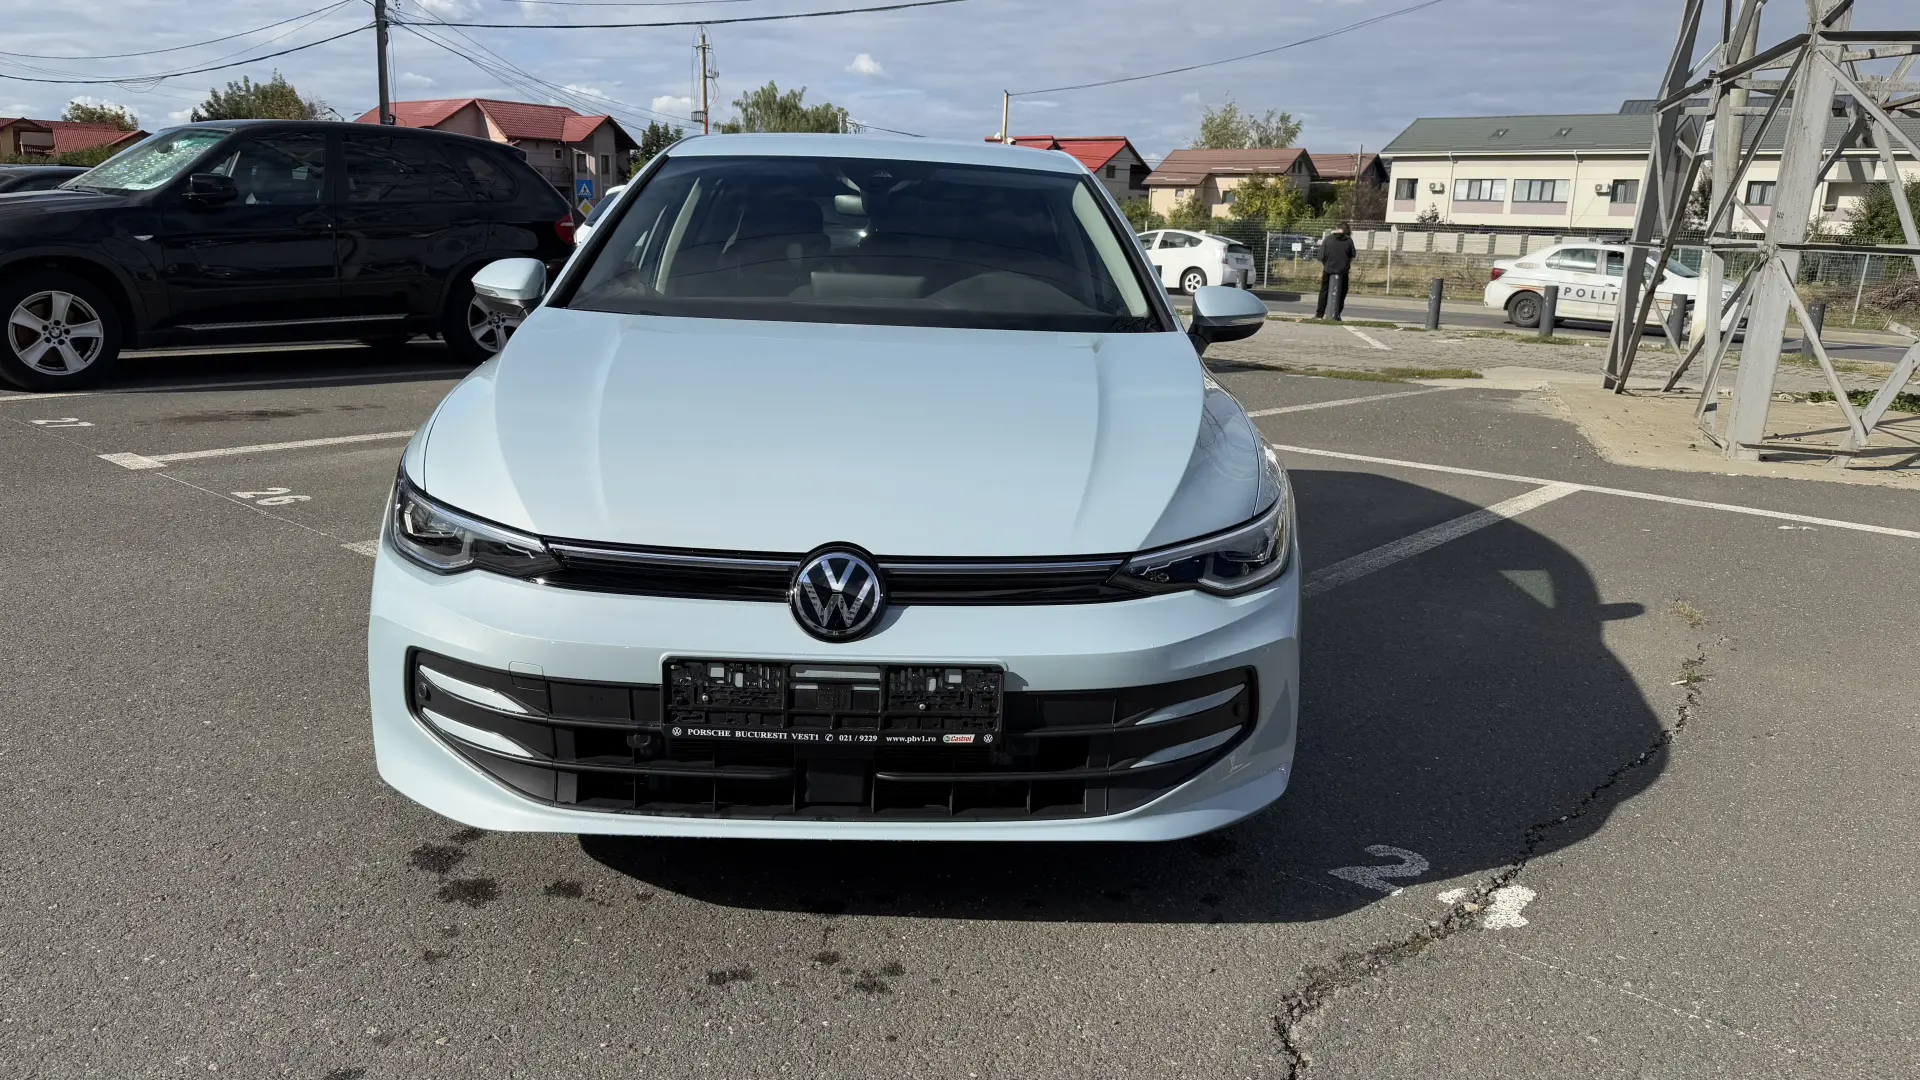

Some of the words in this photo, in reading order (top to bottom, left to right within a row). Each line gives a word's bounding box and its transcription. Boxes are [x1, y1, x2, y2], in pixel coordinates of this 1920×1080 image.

[1563, 286, 1619, 302] POLIT
[230, 487, 311, 506] 26
[687, 728, 731, 737] PORSCHE
[735, 730, 788, 740] BUCURESTI
[838, 734, 853, 742] 021
[859, 734, 878, 742] 9229
[885, 734, 937, 744] www.pbv1.ro
